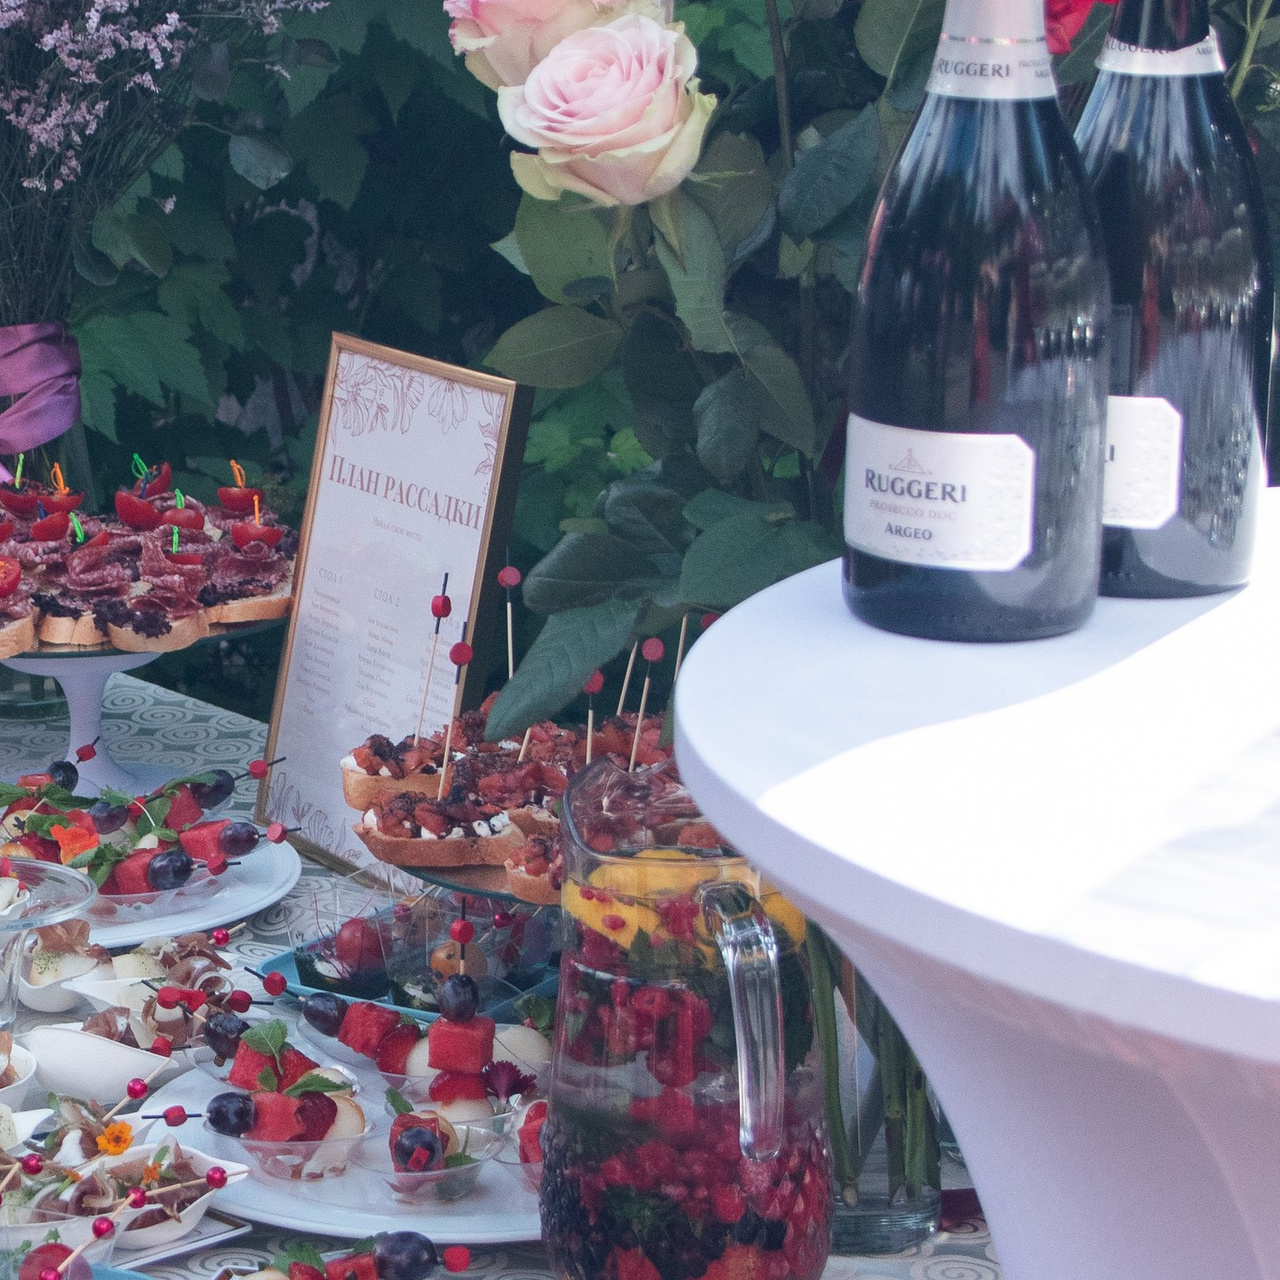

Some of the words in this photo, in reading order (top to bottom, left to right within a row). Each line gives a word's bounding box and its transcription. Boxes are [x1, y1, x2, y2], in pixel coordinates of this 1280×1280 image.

[935, 57, 1011, 78] RUGGERI
[328, 454, 381, 495] ПЛАН
[383, 475, 482, 530] РАССАДКИ
[864, 467, 967, 503] RUGGERI
[869, 499, 923, 518] PROSECCO
[928, 507, 957, 521] DOC
[884, 522, 933, 541] ARGEO
[318, 567, 337, 584] СТОЛ
[374, 588, 393, 605] СТОЛ
[395, 596, 400, 608] 2
